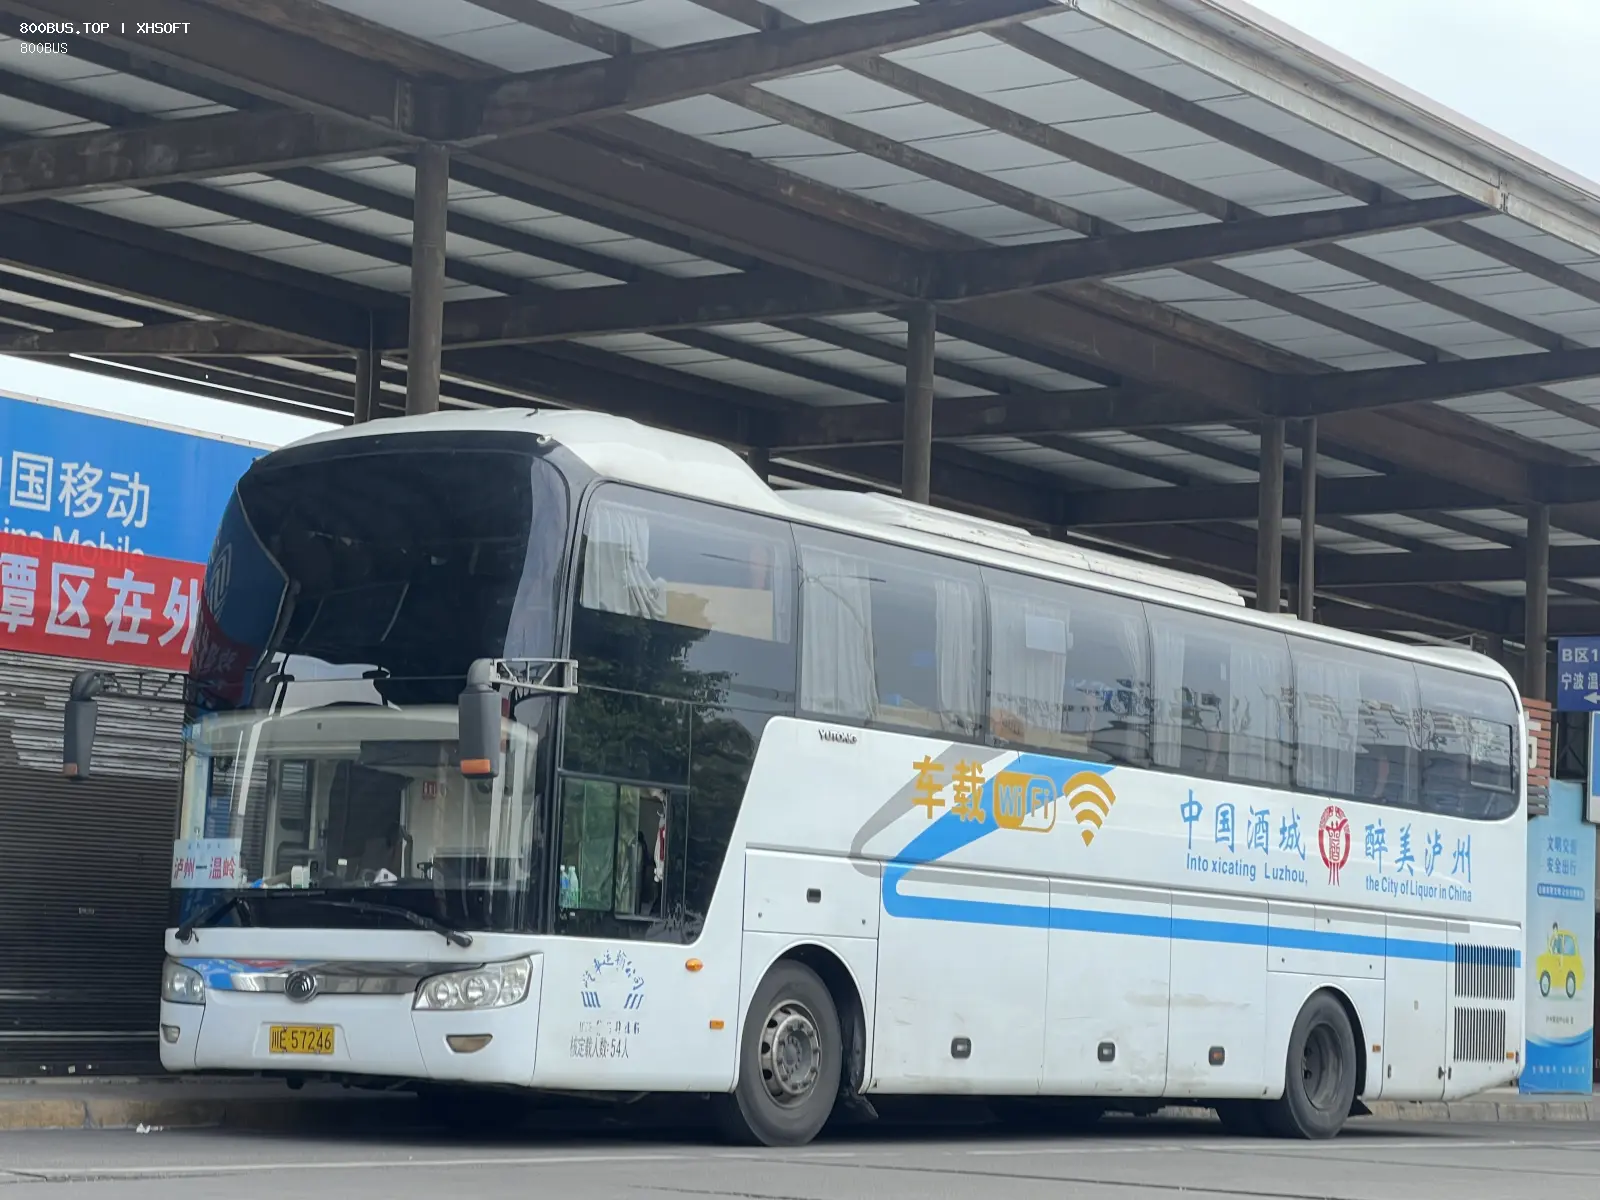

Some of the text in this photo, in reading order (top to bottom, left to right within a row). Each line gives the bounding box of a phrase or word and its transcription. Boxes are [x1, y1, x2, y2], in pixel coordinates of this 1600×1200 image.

[0, 450, 150, 528] 国移动
[1561, 671, 1585, 691] 宁波
[818, 729, 858, 744] YUTONG
[912, 754, 986, 823] 车载
[1180, 788, 1472, 883] 中国酒城 醉美泸州
[1264, 865, 1308, 886] Luzhou,
[1546, 857, 1576, 877] 安全出行
[1366, 875, 1472, 902] the City of Liquor in China
